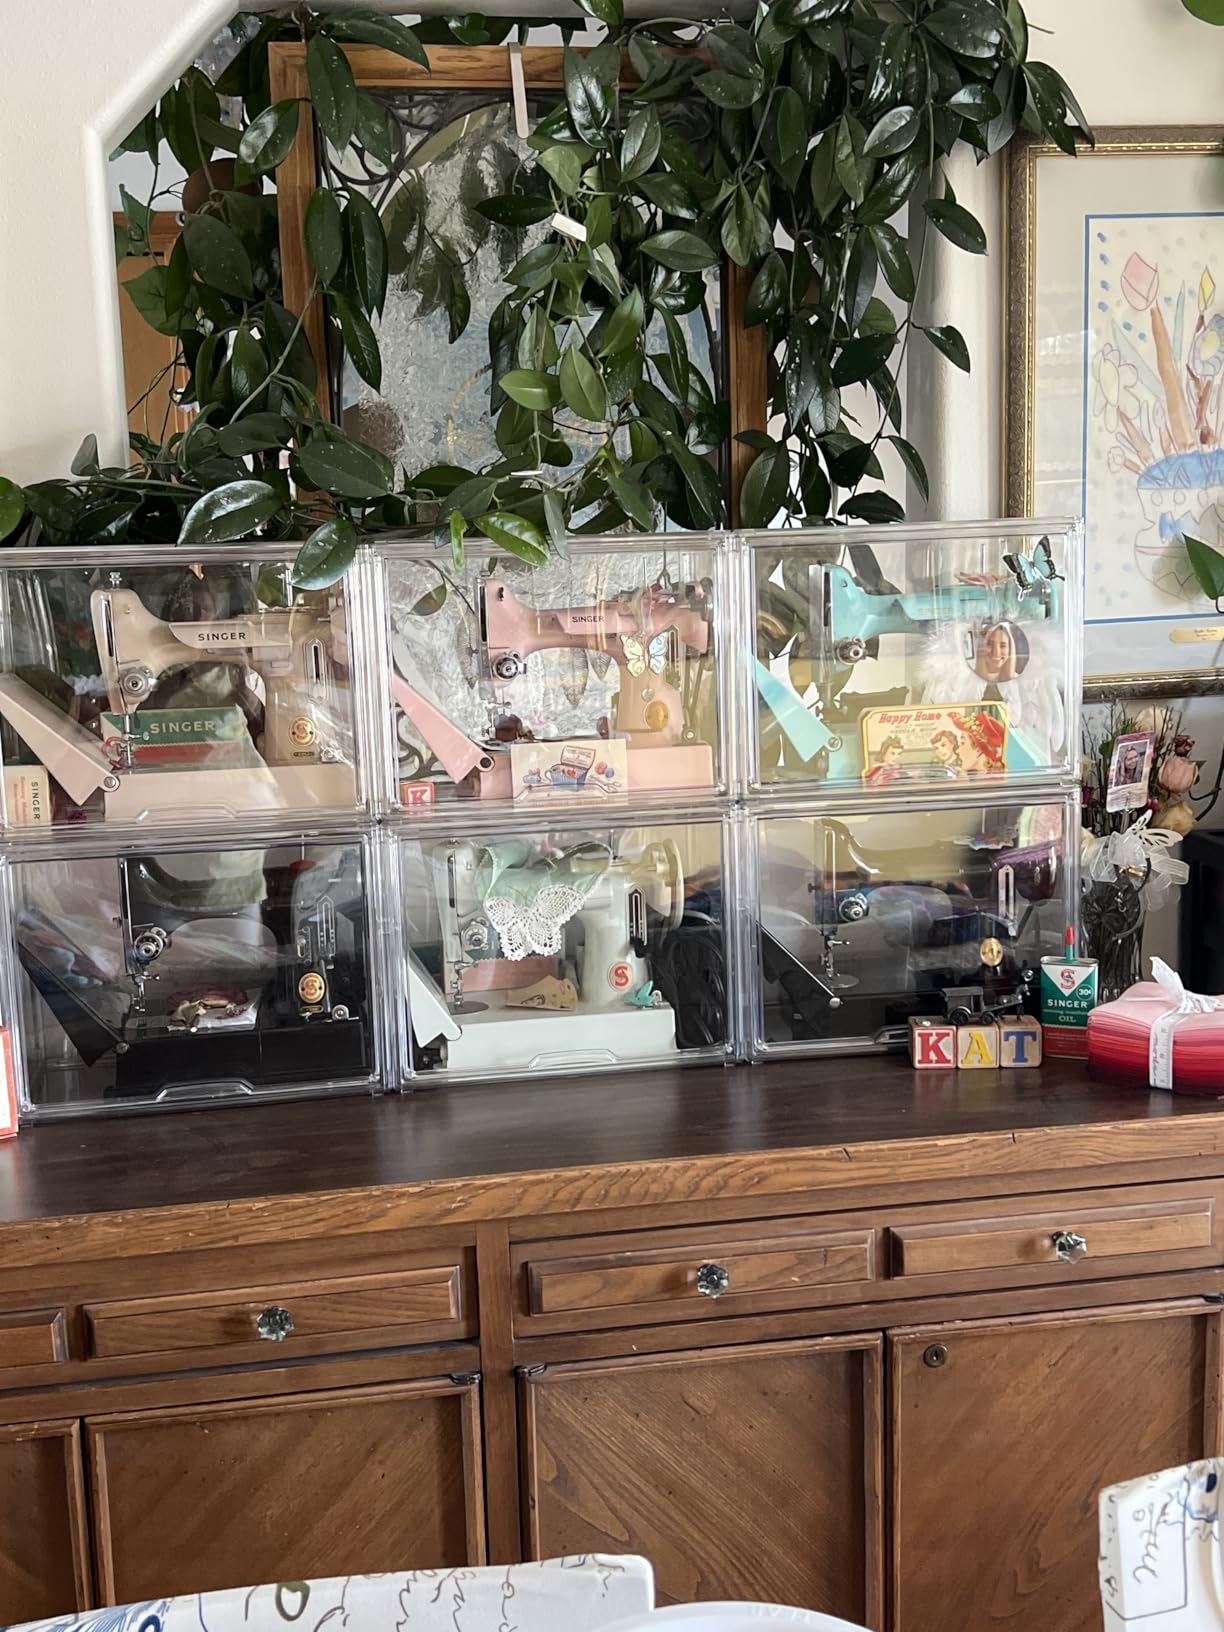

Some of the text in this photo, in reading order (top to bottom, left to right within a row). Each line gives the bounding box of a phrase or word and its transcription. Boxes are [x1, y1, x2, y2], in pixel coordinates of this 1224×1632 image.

[198, 632, 246, 641] SINGER
[878, 711, 942, 725] Happy Home
[150, 720, 215, 734] SINGER
[31, 782, 41, 820] SINGER
[614, 965, 629, 987] S
[1060, 968, 1076, 990] S
[1047, 998, 1088, 1009] SINGER
[1058, 1015, 1077, 1023] OIL
